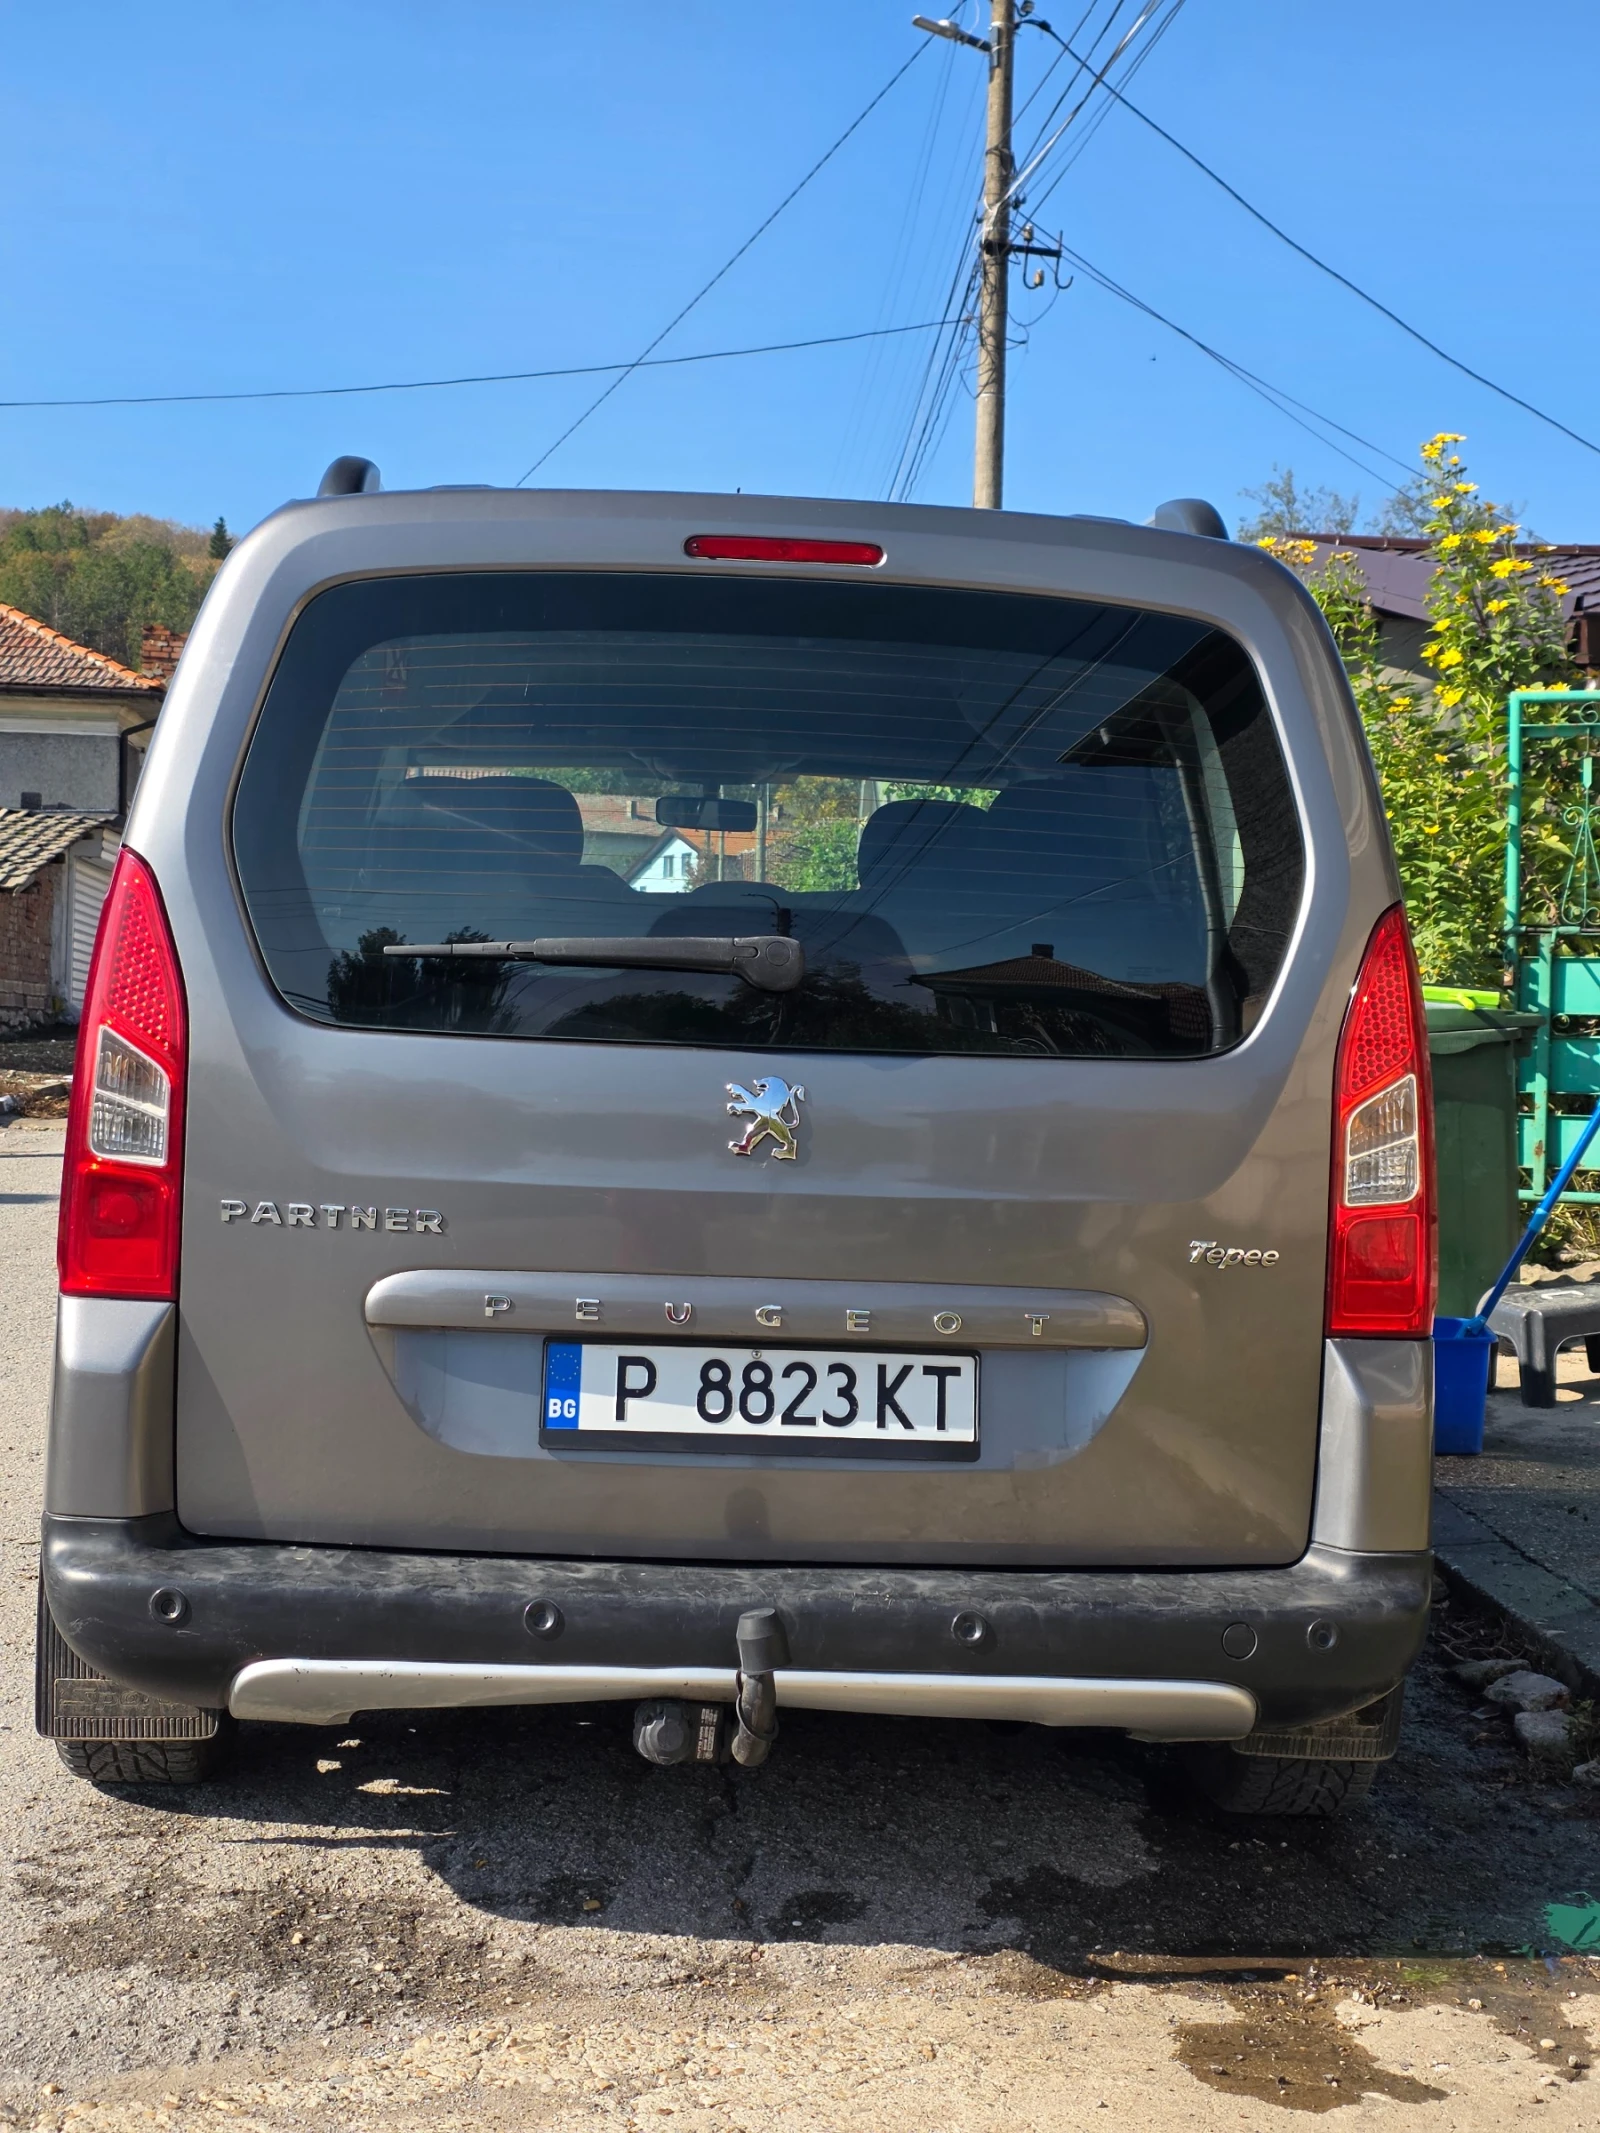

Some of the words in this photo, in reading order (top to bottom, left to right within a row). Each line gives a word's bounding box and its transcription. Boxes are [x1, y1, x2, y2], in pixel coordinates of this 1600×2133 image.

[220, 1199, 443, 1233] PARTNER
[1189, 1240, 1280, 1269] Tepee
[485, 1295, 1050, 1335] PEUGEOT
[548, 1398, 577, 1419] BG
[615, 1355, 657, 1422] P
[696, 1358, 860, 1427] 8823
[876, 1363, 962, 1431] KT
